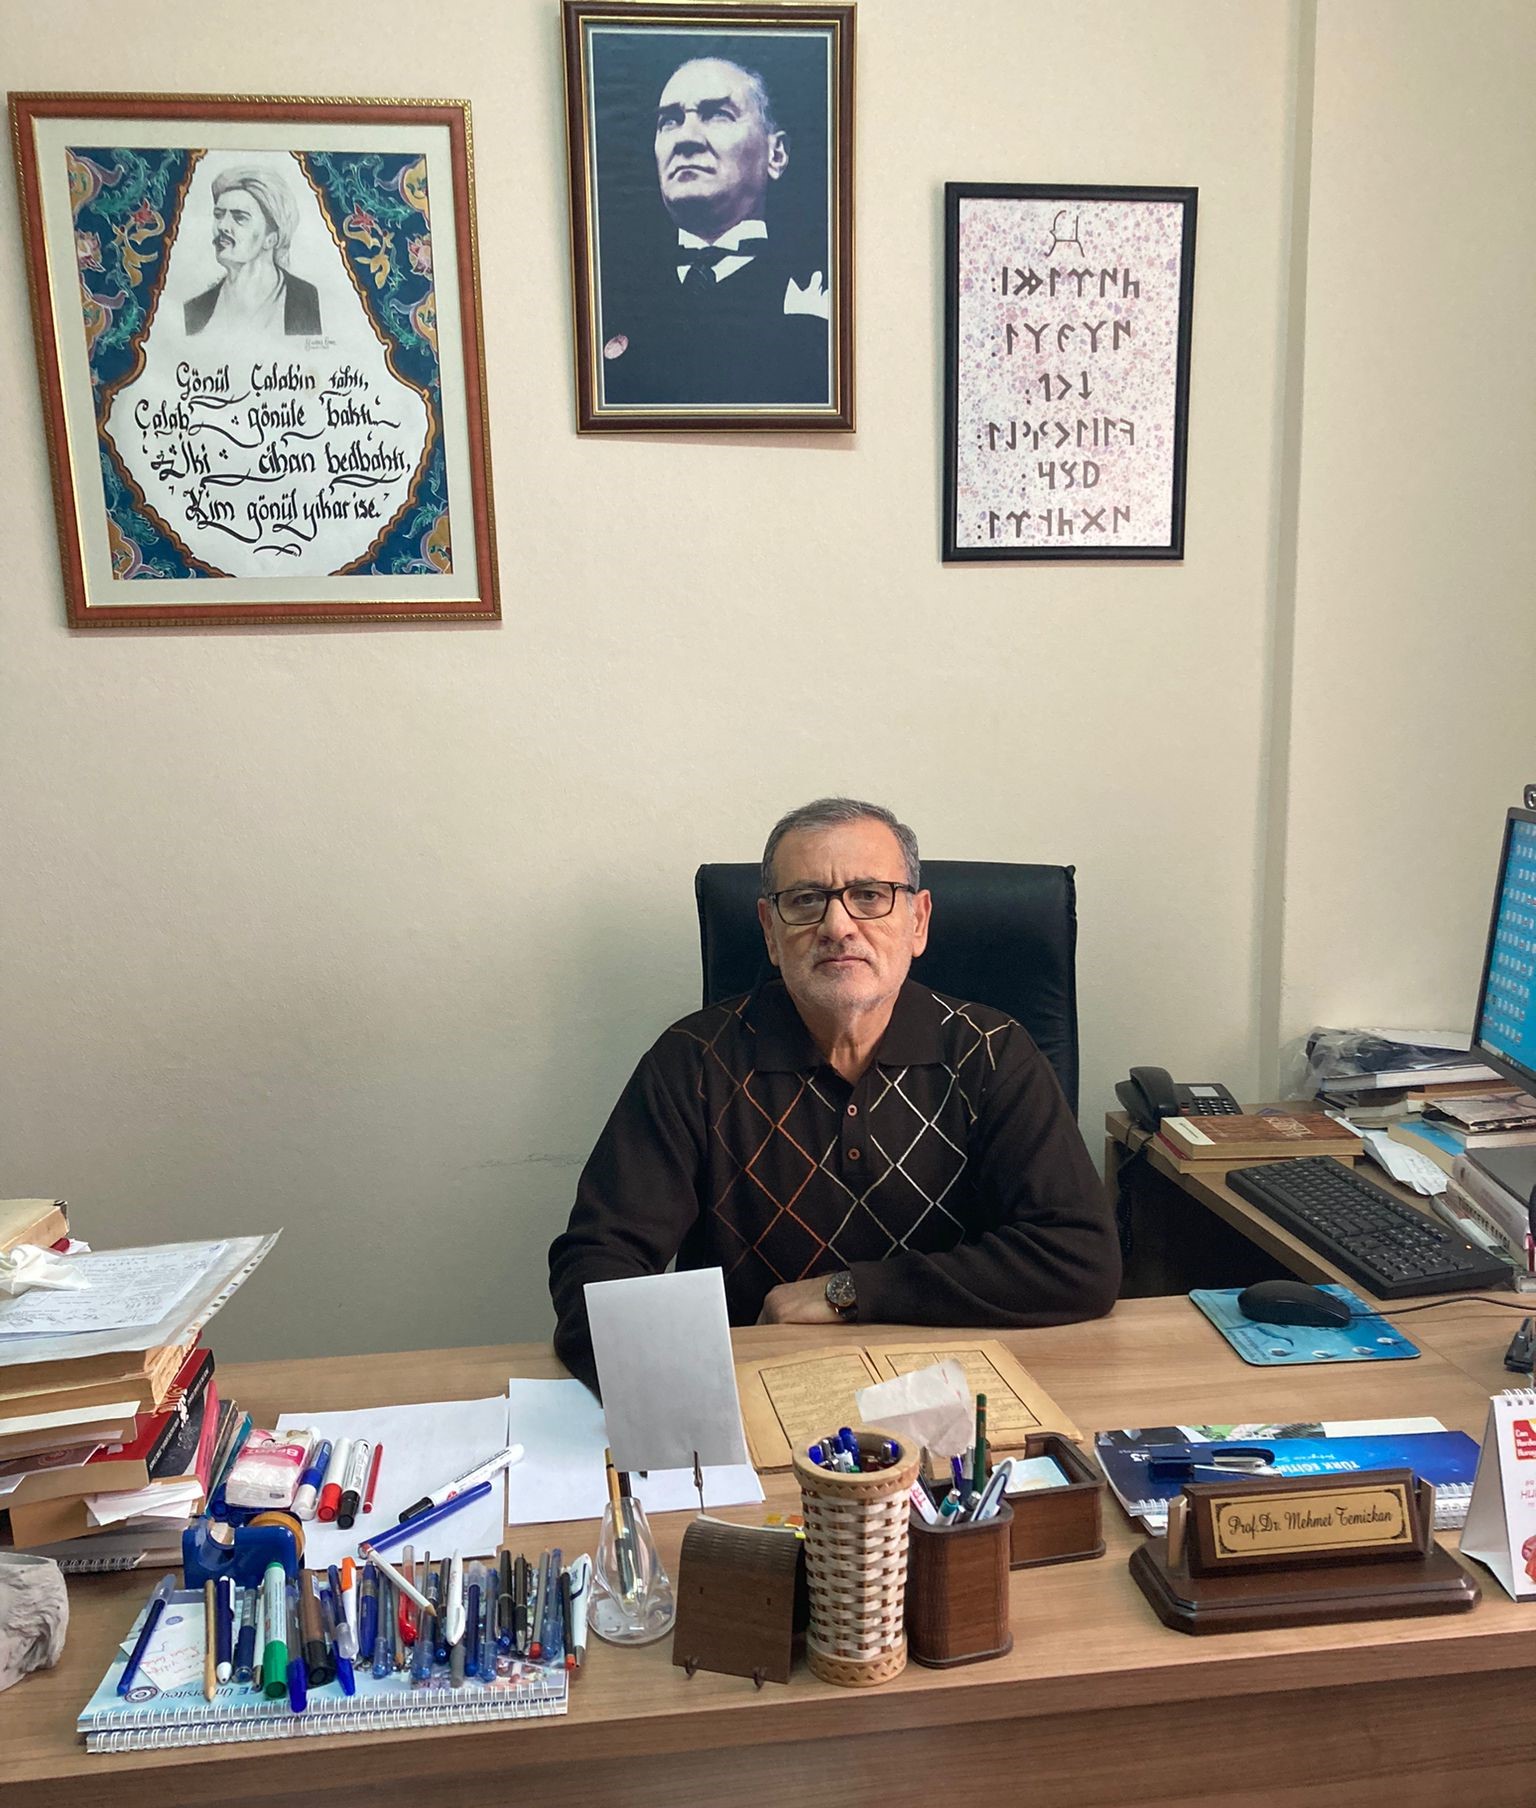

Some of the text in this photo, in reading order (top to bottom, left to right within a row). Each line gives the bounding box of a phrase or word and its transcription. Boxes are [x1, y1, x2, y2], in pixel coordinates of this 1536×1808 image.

[176, 361, 230, 400] Gönül
[247, 398, 306, 445] gönüle
[258, 441, 316, 474] cihan
[1284, 1510, 1334, 1530] Mehmet
[1334, 1504, 1392, 1527] Temizkan
[160, 1687, 234, 1700] Ünersitesi
